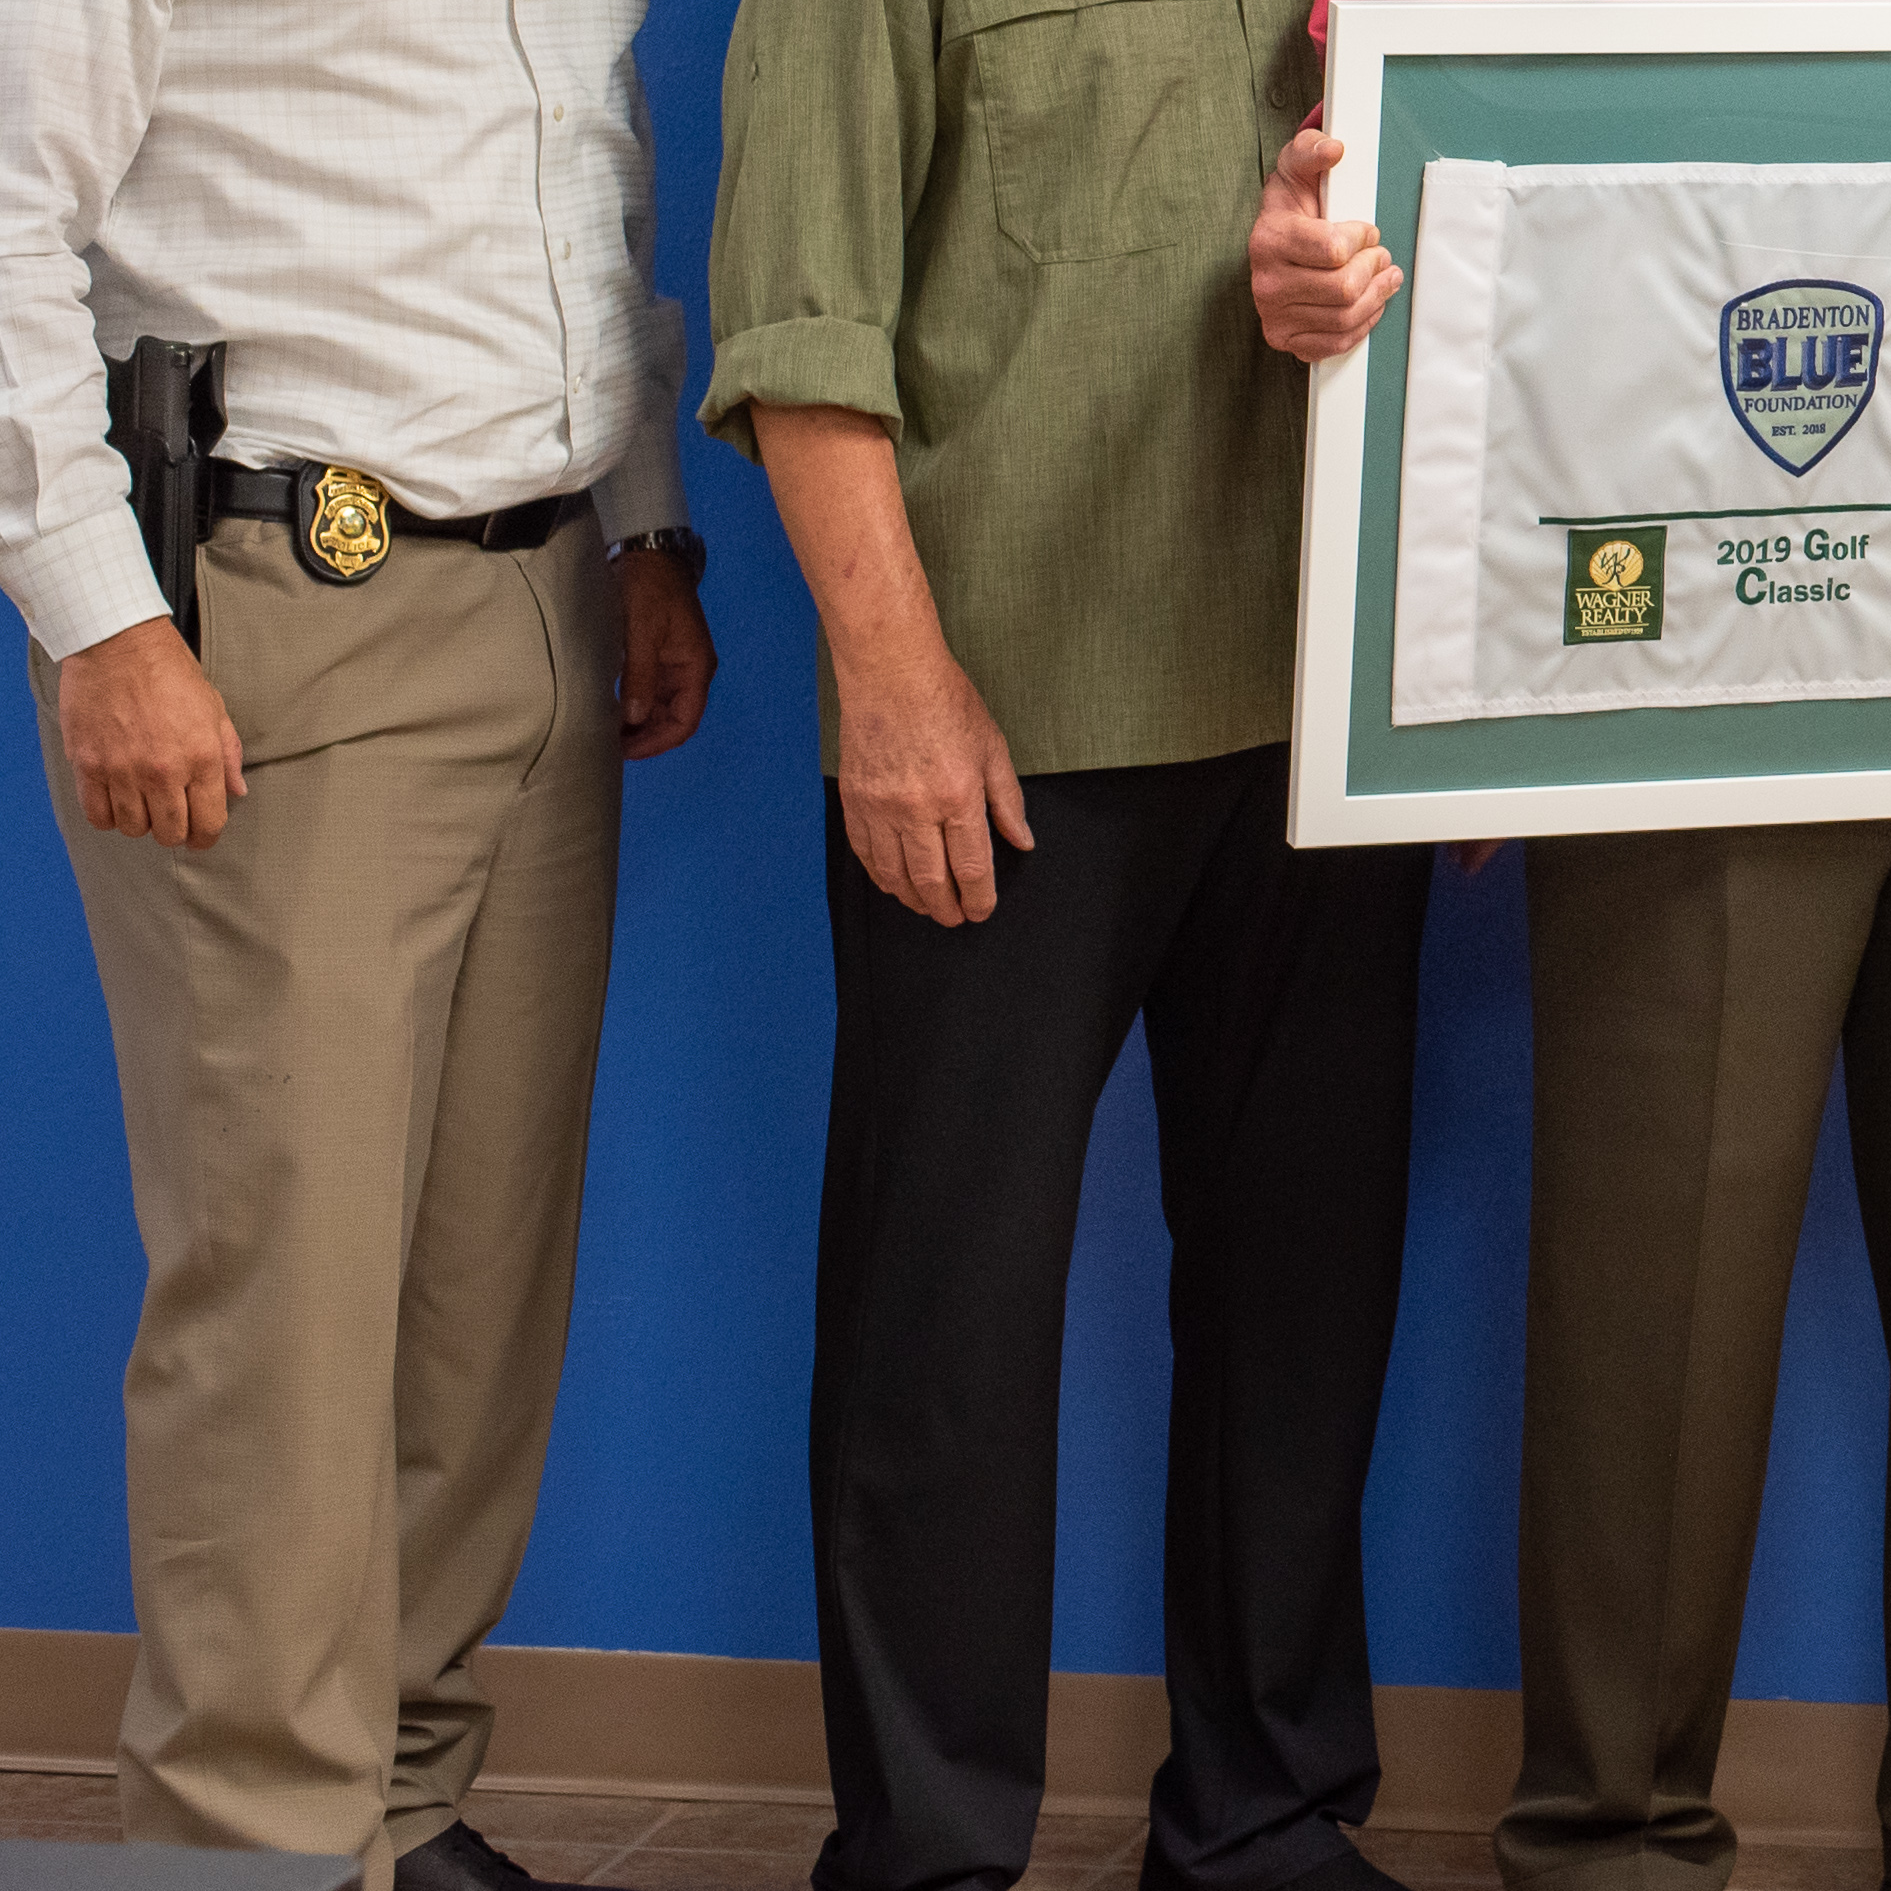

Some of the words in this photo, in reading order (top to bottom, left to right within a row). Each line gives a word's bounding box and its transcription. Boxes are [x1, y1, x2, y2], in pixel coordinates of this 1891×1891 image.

[1736, 304, 1871, 330] BRADENTON
[1736, 333, 1870, 392] BLUE
[1744, 394, 1858, 413] FOUNDATION
[1771, 425, 1796, 436] EST.
[1802, 423, 1826, 435] 2018
[1717, 536, 1791, 565] 2019
[1804, 528, 1870, 561] Golf
[1735, 566, 1851, 605] Classic
[1575, 590, 1655, 608] WAGNER
[1580, 607, 1648, 626] REALTY
